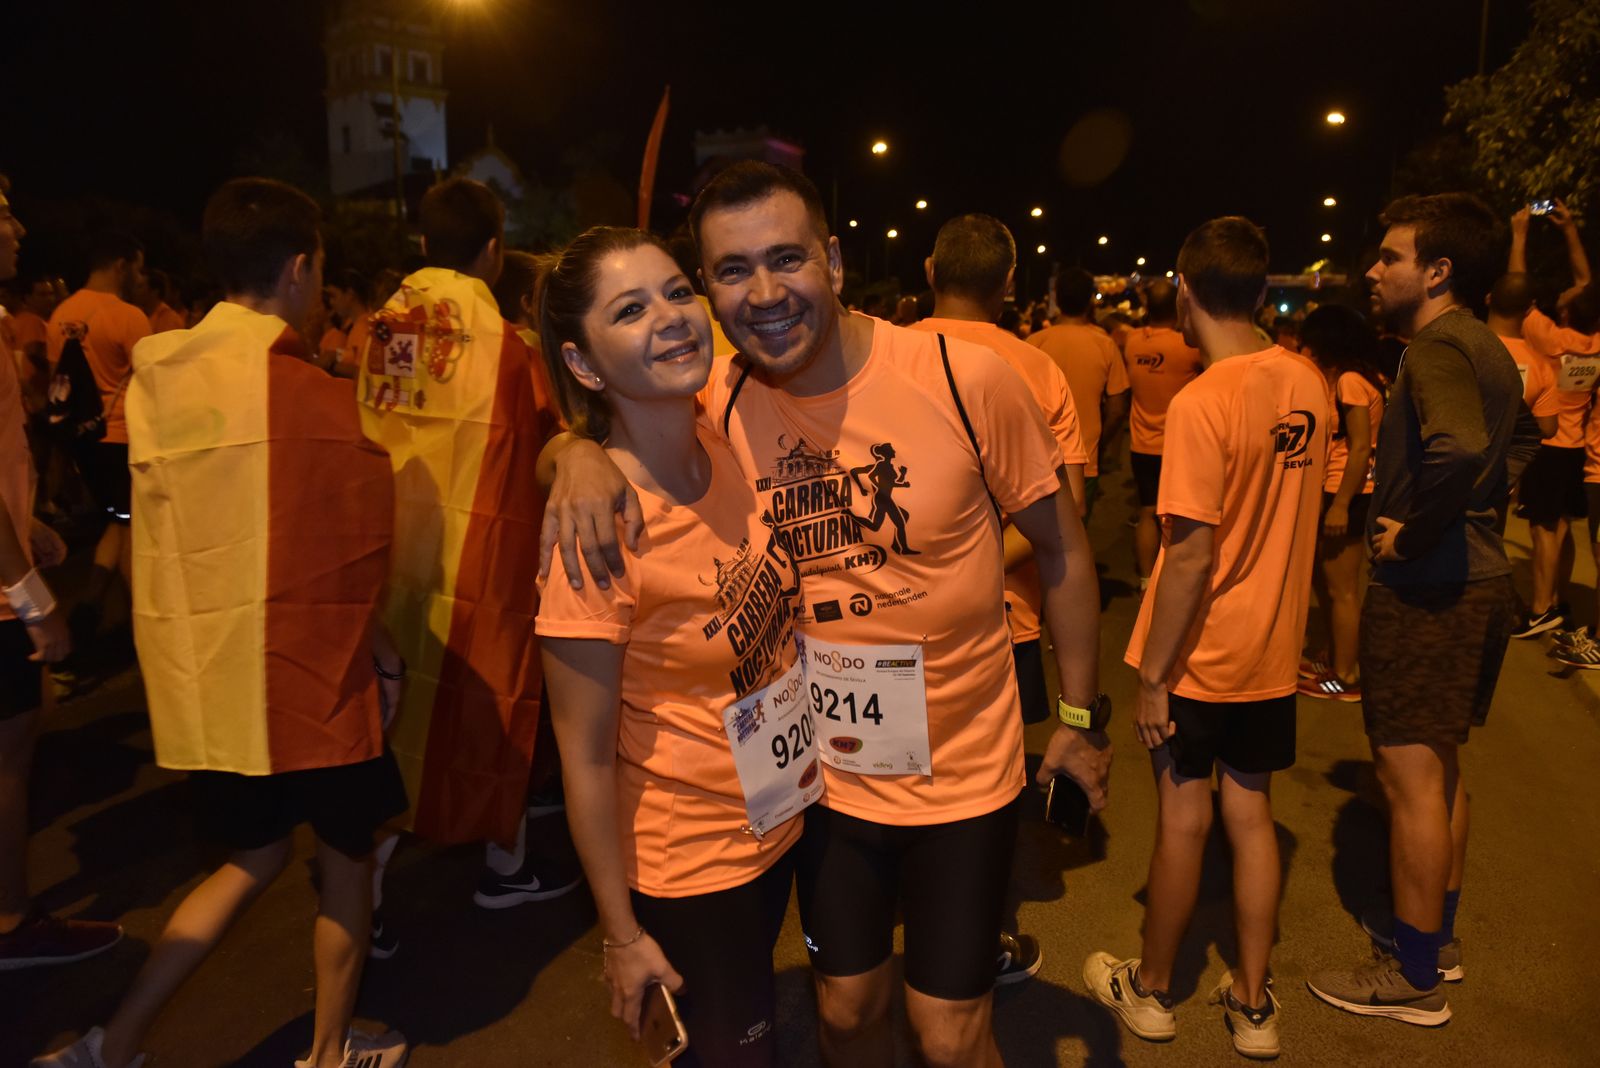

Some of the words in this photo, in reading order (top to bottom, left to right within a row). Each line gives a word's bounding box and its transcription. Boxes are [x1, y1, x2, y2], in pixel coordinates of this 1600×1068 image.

[754, 476, 772, 493] XXXI
[772, 476, 853, 524] CARRERA
[780, 514, 864, 563] OCTURNA
[800, 564, 842, 578] uadalquivir
[727, 559, 783, 658] CARRERA
[874, 587, 911, 605] nationale
[877, 591, 930, 609] nederlanden
[702, 615, 723, 642] XXXI
[810, 682, 884, 728] 9214
[771, 704, 815, 769] 920
